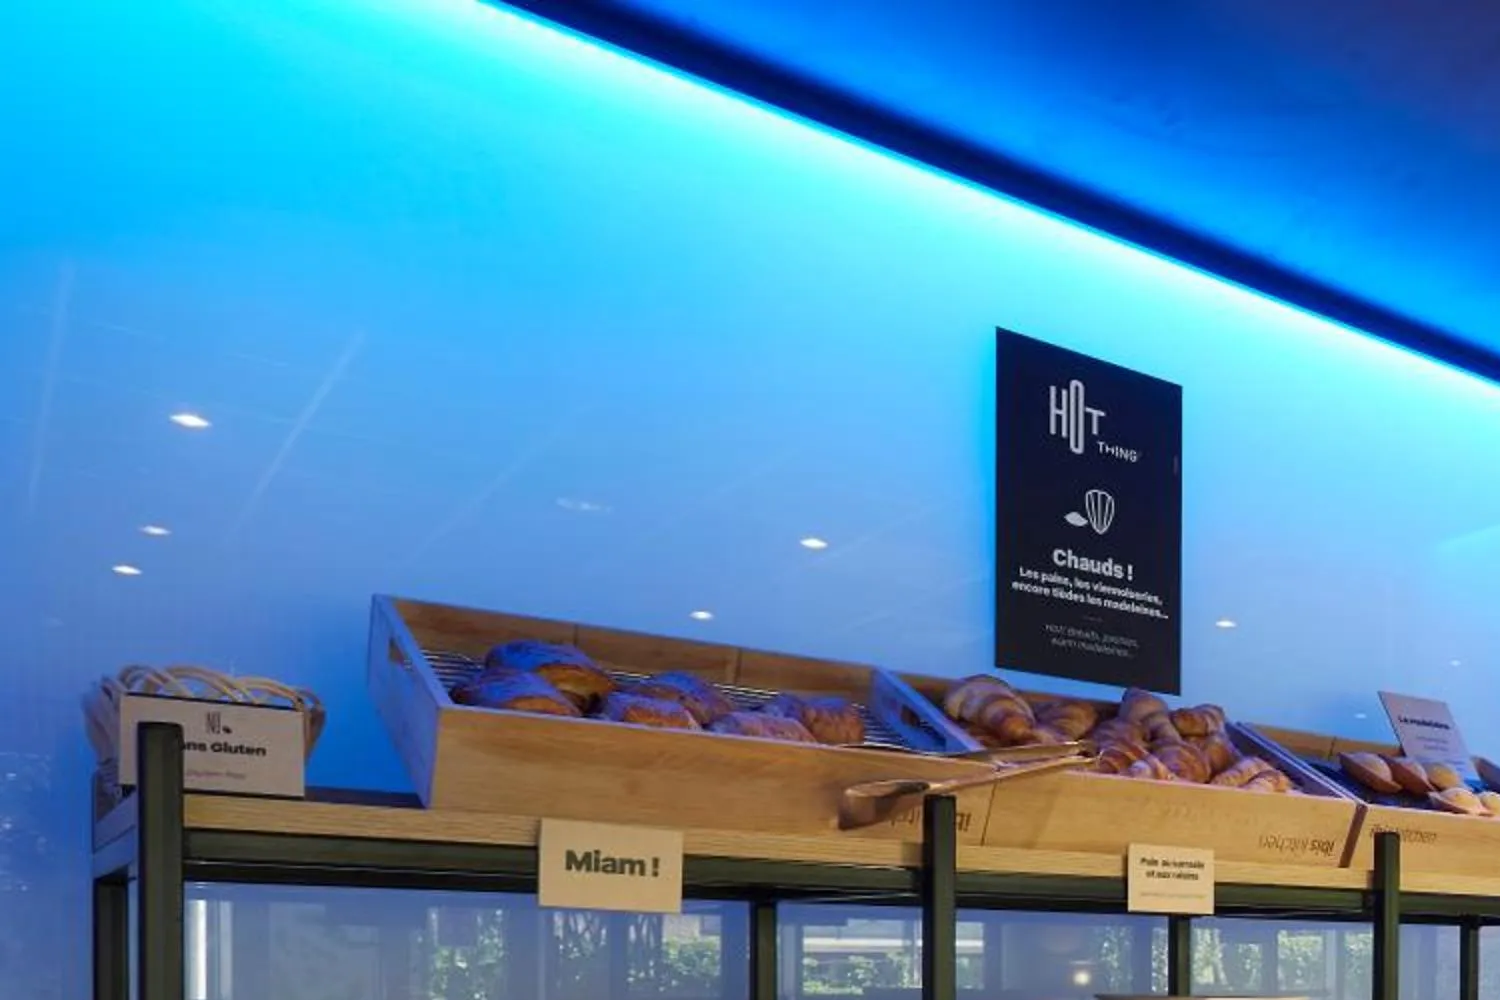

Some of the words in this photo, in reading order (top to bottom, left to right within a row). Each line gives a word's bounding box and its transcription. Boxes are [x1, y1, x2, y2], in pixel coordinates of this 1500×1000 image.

[1049, 379, 1106, 454] HOT
[1097, 440, 1137, 463] THING
[1019, 566, 1039, 580] Les
[1052, 548, 1124, 579] Chauds
[1011, 581, 1050, 596] encore
[210, 741, 267, 757] Gluten
[565, 849, 646, 877] Miam
[652, 857, 660, 877] !
